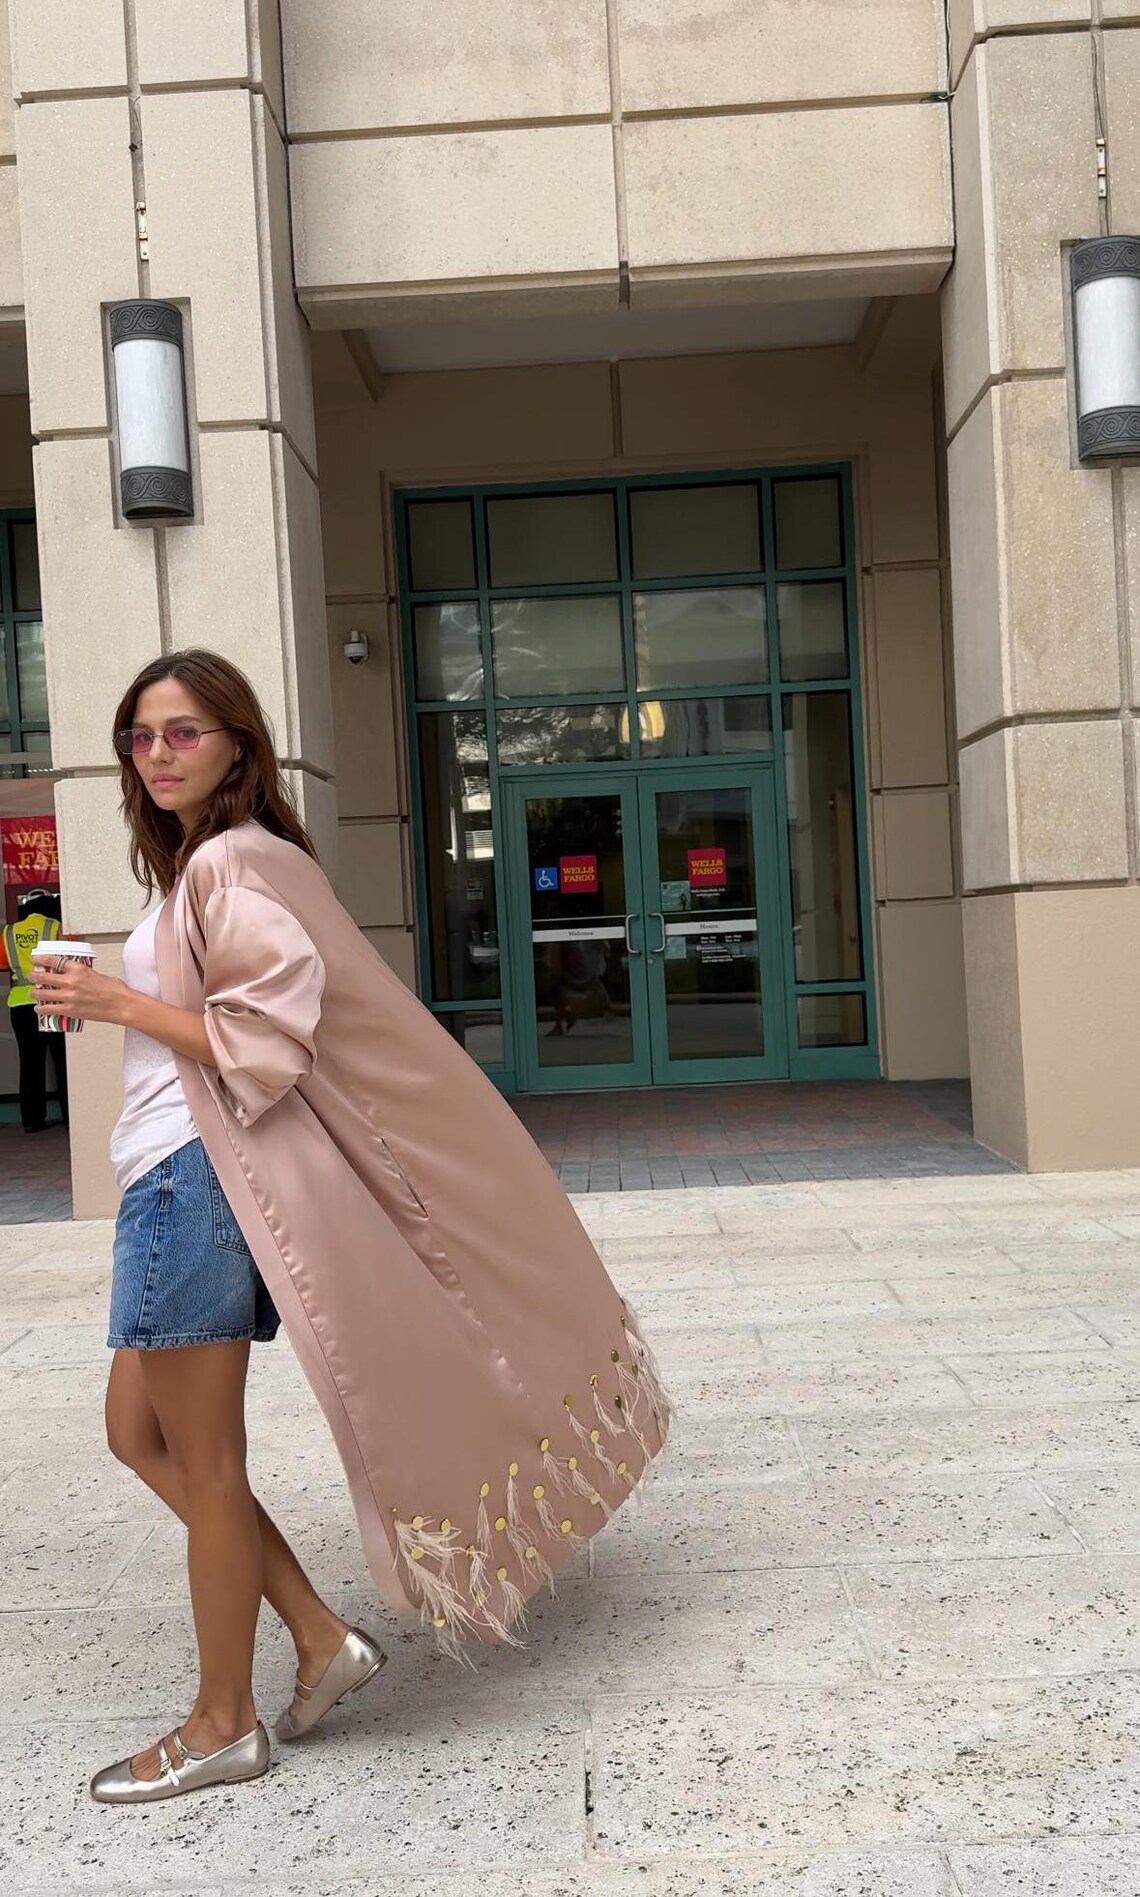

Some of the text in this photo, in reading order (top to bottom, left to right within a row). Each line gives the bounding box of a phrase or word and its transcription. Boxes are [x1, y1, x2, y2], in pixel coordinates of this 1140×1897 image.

[691, 859, 724, 867] WELLS
[562, 866, 595, 875] WELLS
[692, 867, 724, 876] FARGO
[564, 874, 595, 883] FARGO
